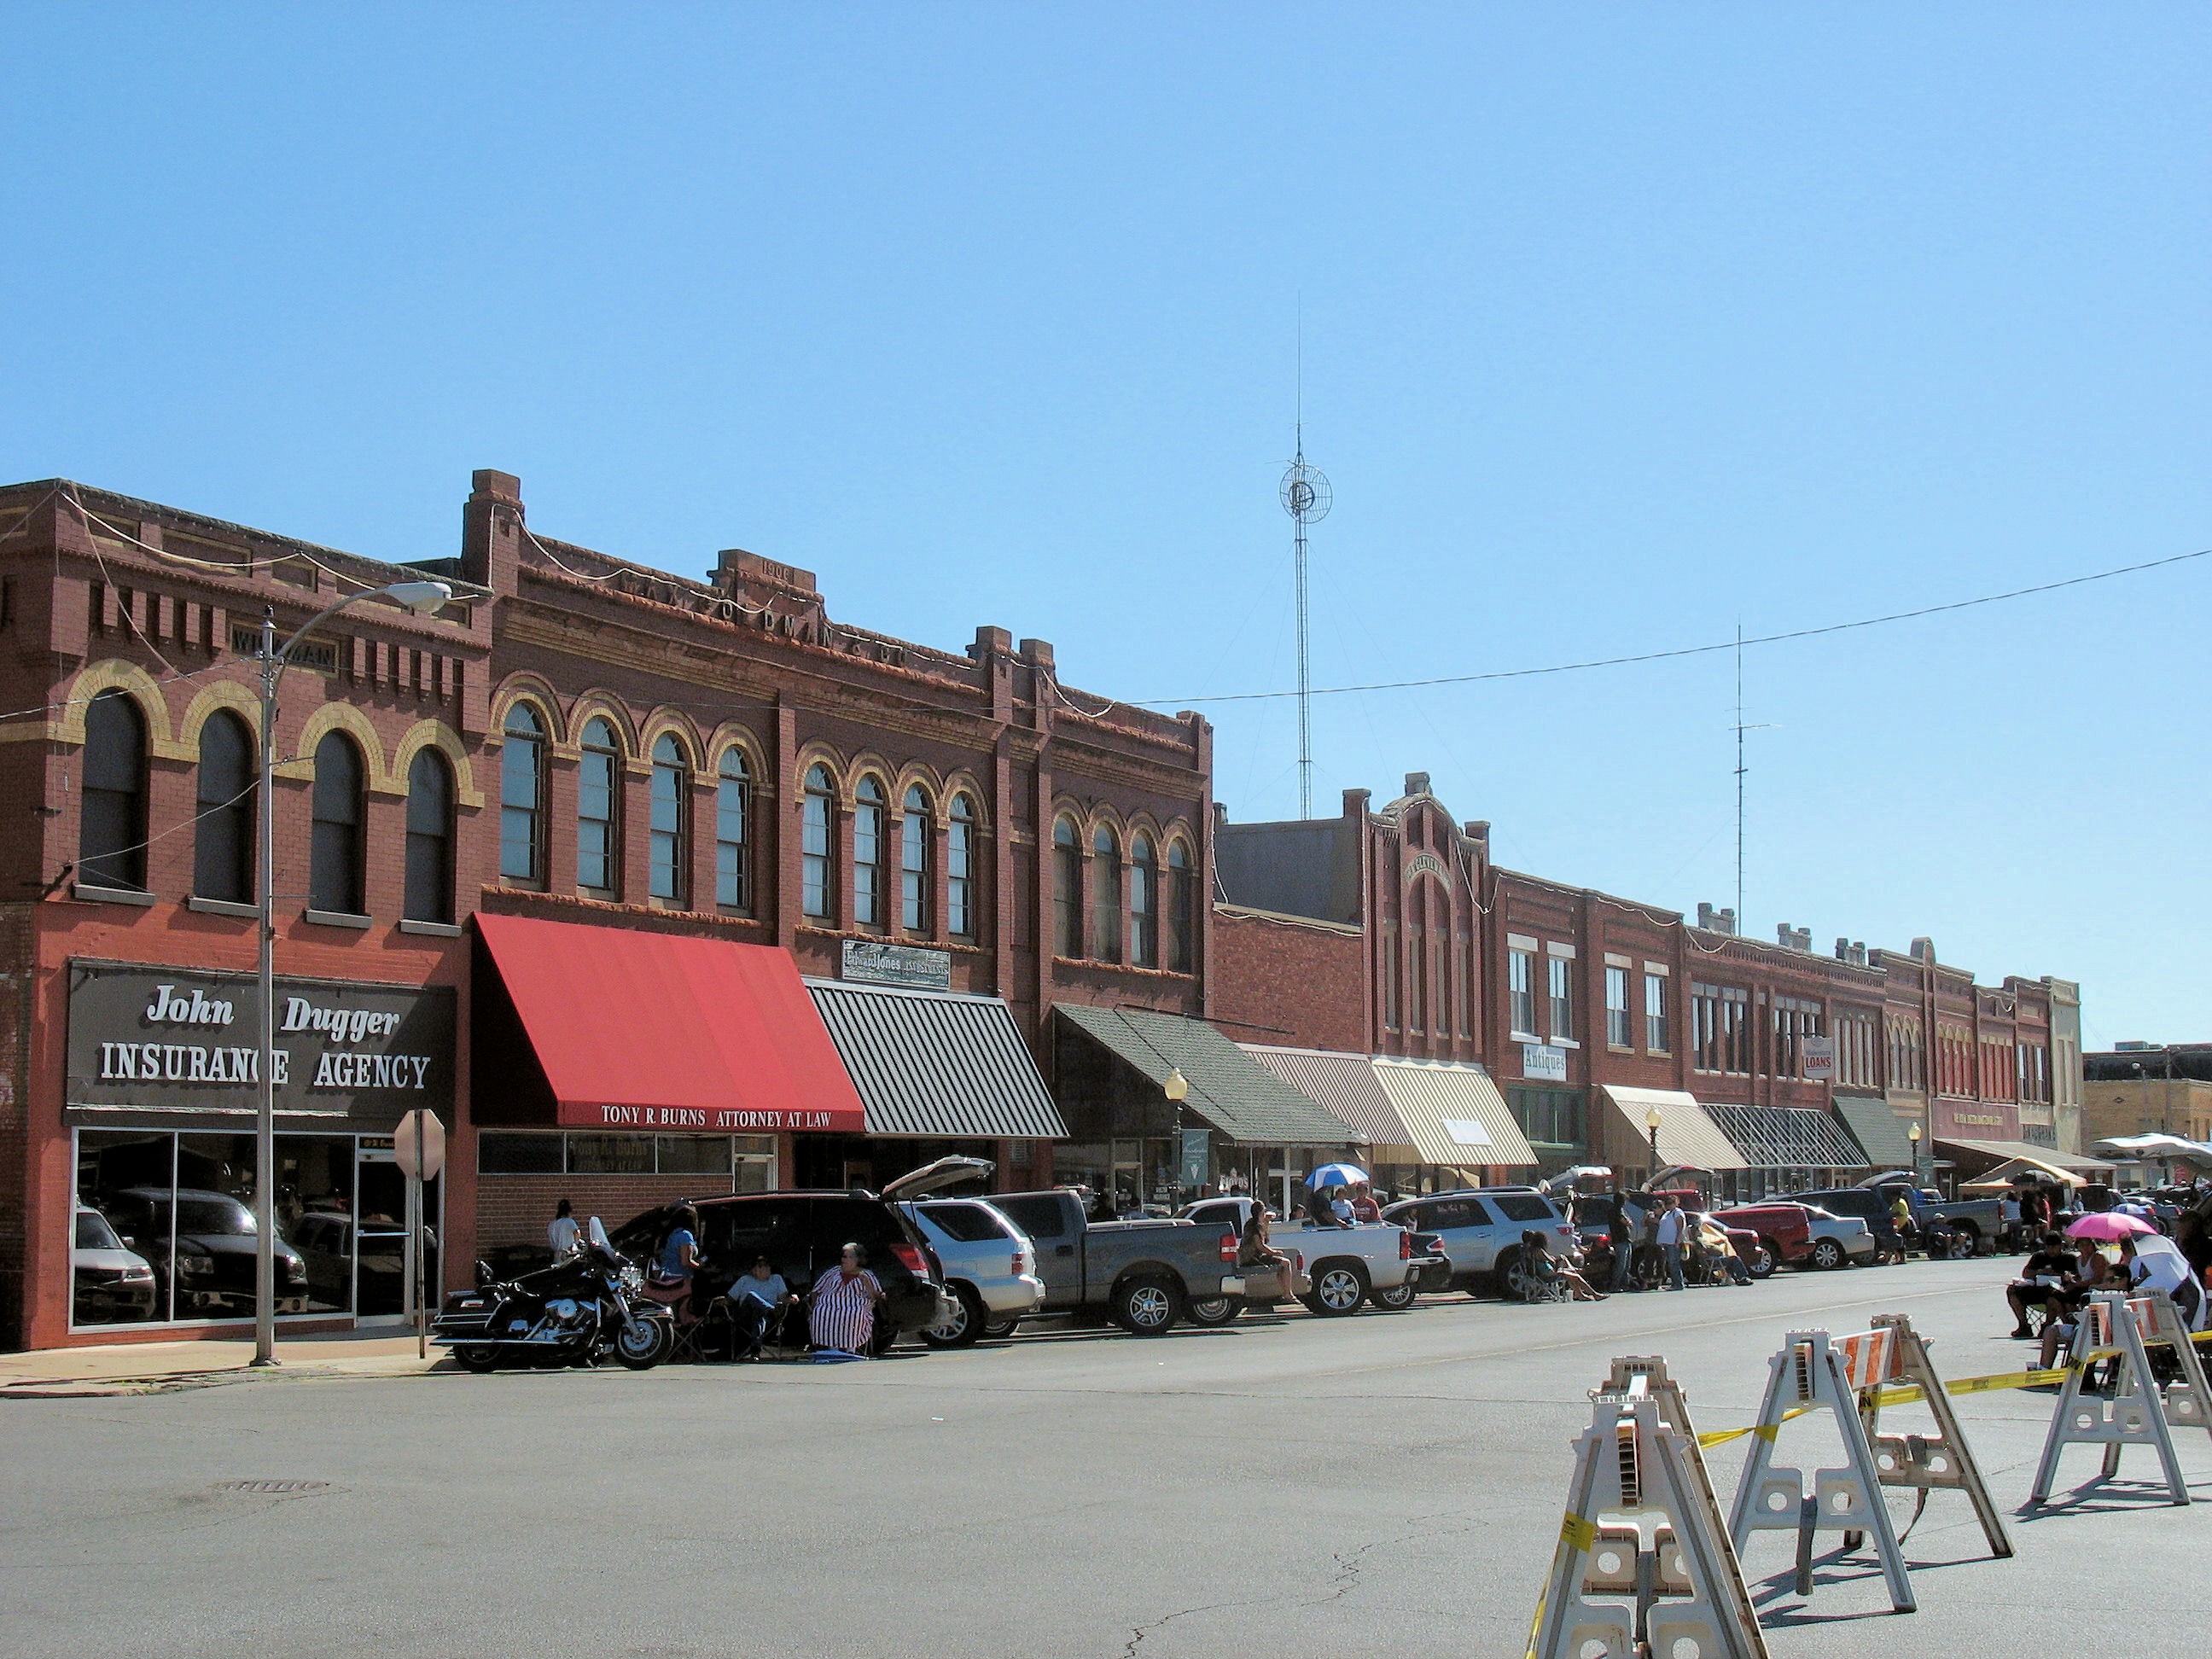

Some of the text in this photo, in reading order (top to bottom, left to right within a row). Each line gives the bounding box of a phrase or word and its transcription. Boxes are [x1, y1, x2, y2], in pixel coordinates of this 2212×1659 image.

[147, 984, 401, 1043] John Dugger
[313, 1051, 432, 1089] AGENCY
[1525, 1049, 1565, 1075] Antiques
[1806, 1056, 1831, 1068] LOANS
[602, 1105, 640, 1125] TONY
[661, 1109, 707, 1126] BURNS
[715, 1110, 783, 1128] ATTORNEY
[787, 1112, 802, 1128] AT
[806, 1113, 832, 1128] LAW
